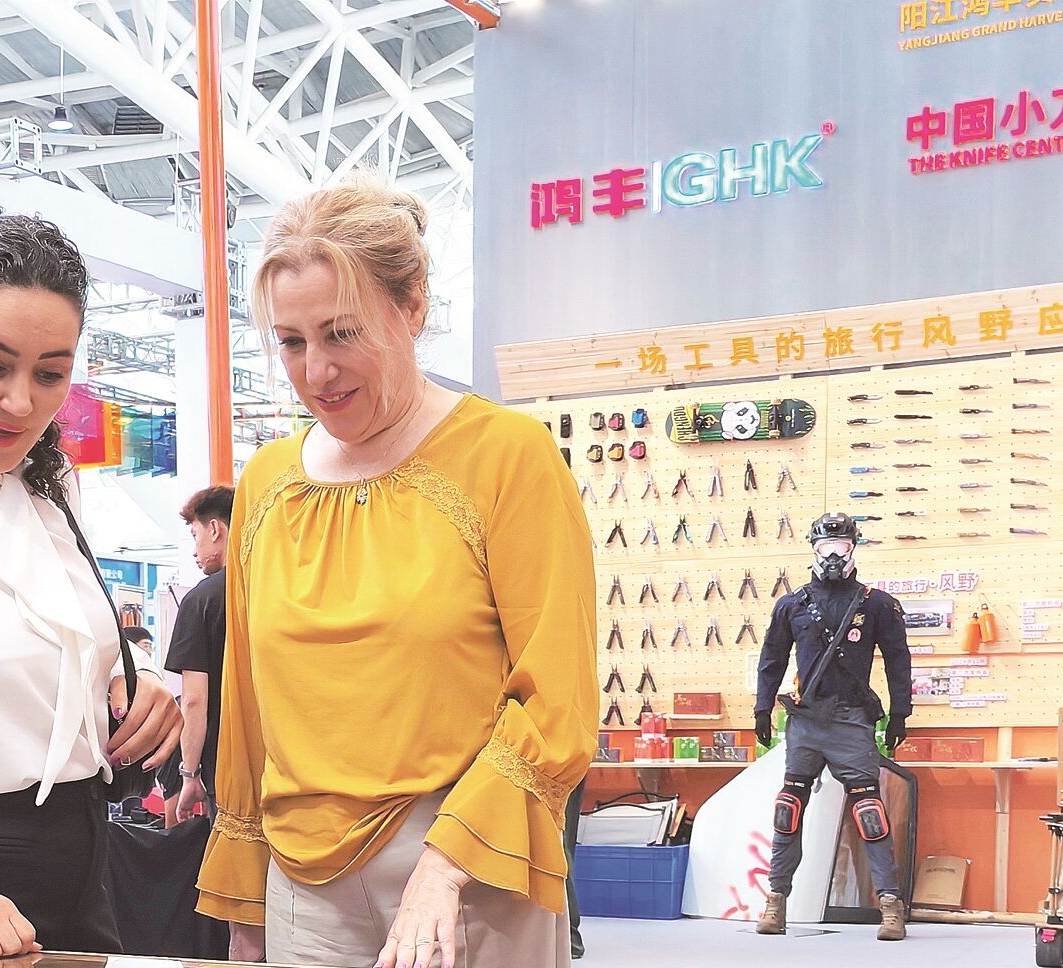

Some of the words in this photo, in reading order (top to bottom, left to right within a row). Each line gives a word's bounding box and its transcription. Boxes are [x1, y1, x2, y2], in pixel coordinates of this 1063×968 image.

[897, 28, 970, 50] YANGJIANG
[971, 19, 1017, 38] GRAND
[1019, 10, 1063, 29] HARVE
[908, 154, 947, 175] THE
[949, 143, 1010, 168] KNIFE
[530, 168, 646, 228] 鸿丰
[662, 133, 823, 206] GHK
